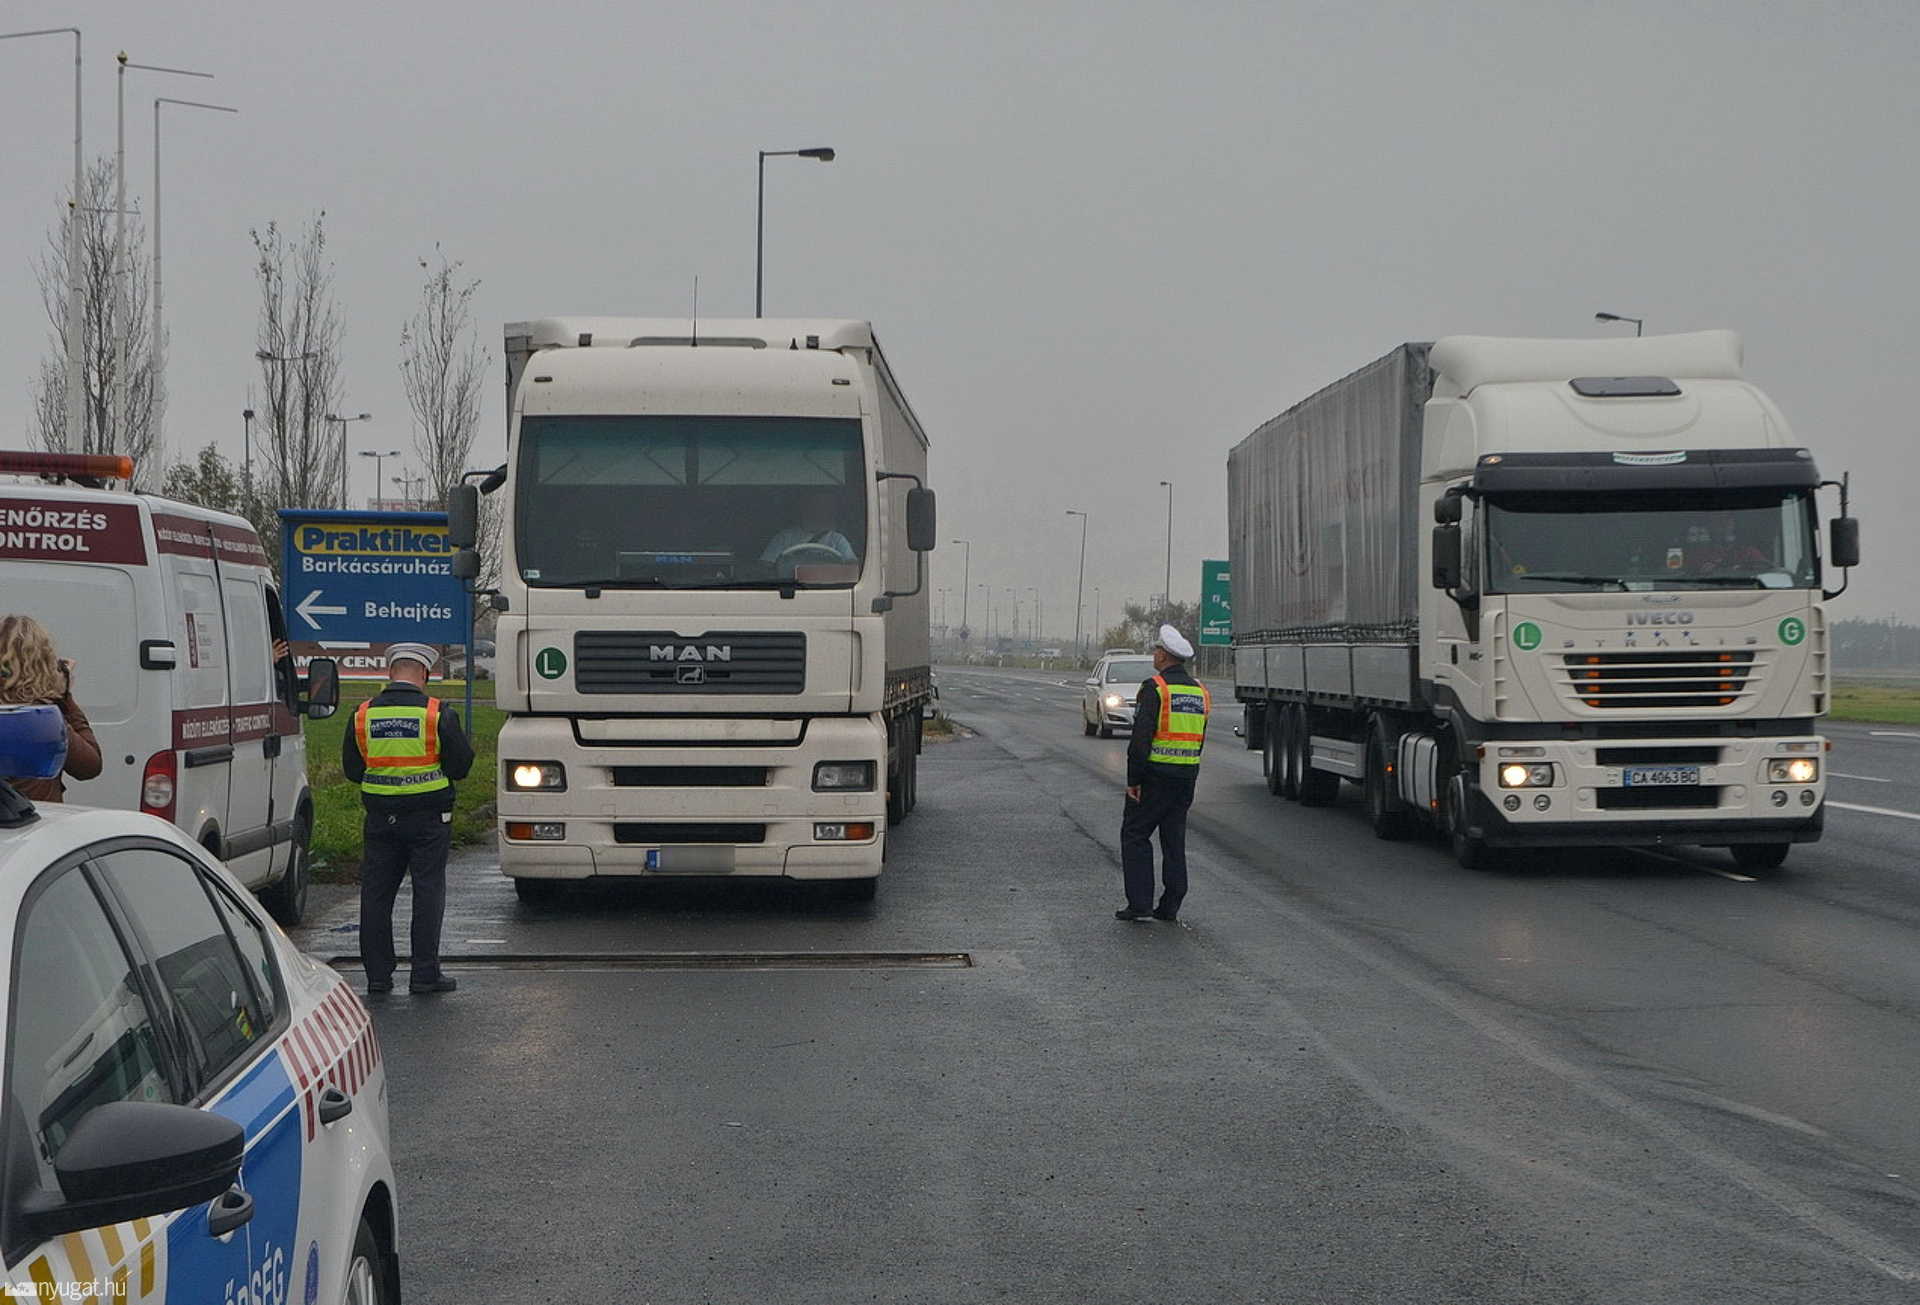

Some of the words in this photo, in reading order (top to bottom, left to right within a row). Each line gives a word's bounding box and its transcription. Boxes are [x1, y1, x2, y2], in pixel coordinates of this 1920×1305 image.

[302, 527, 451, 553] Praktiker
[302, 556, 450, 575] Barkácsáruház
[364, 601, 452, 623] Behajtás
[1627, 611, 1694, 625] IVECO
[650, 645, 731, 661] MAN
